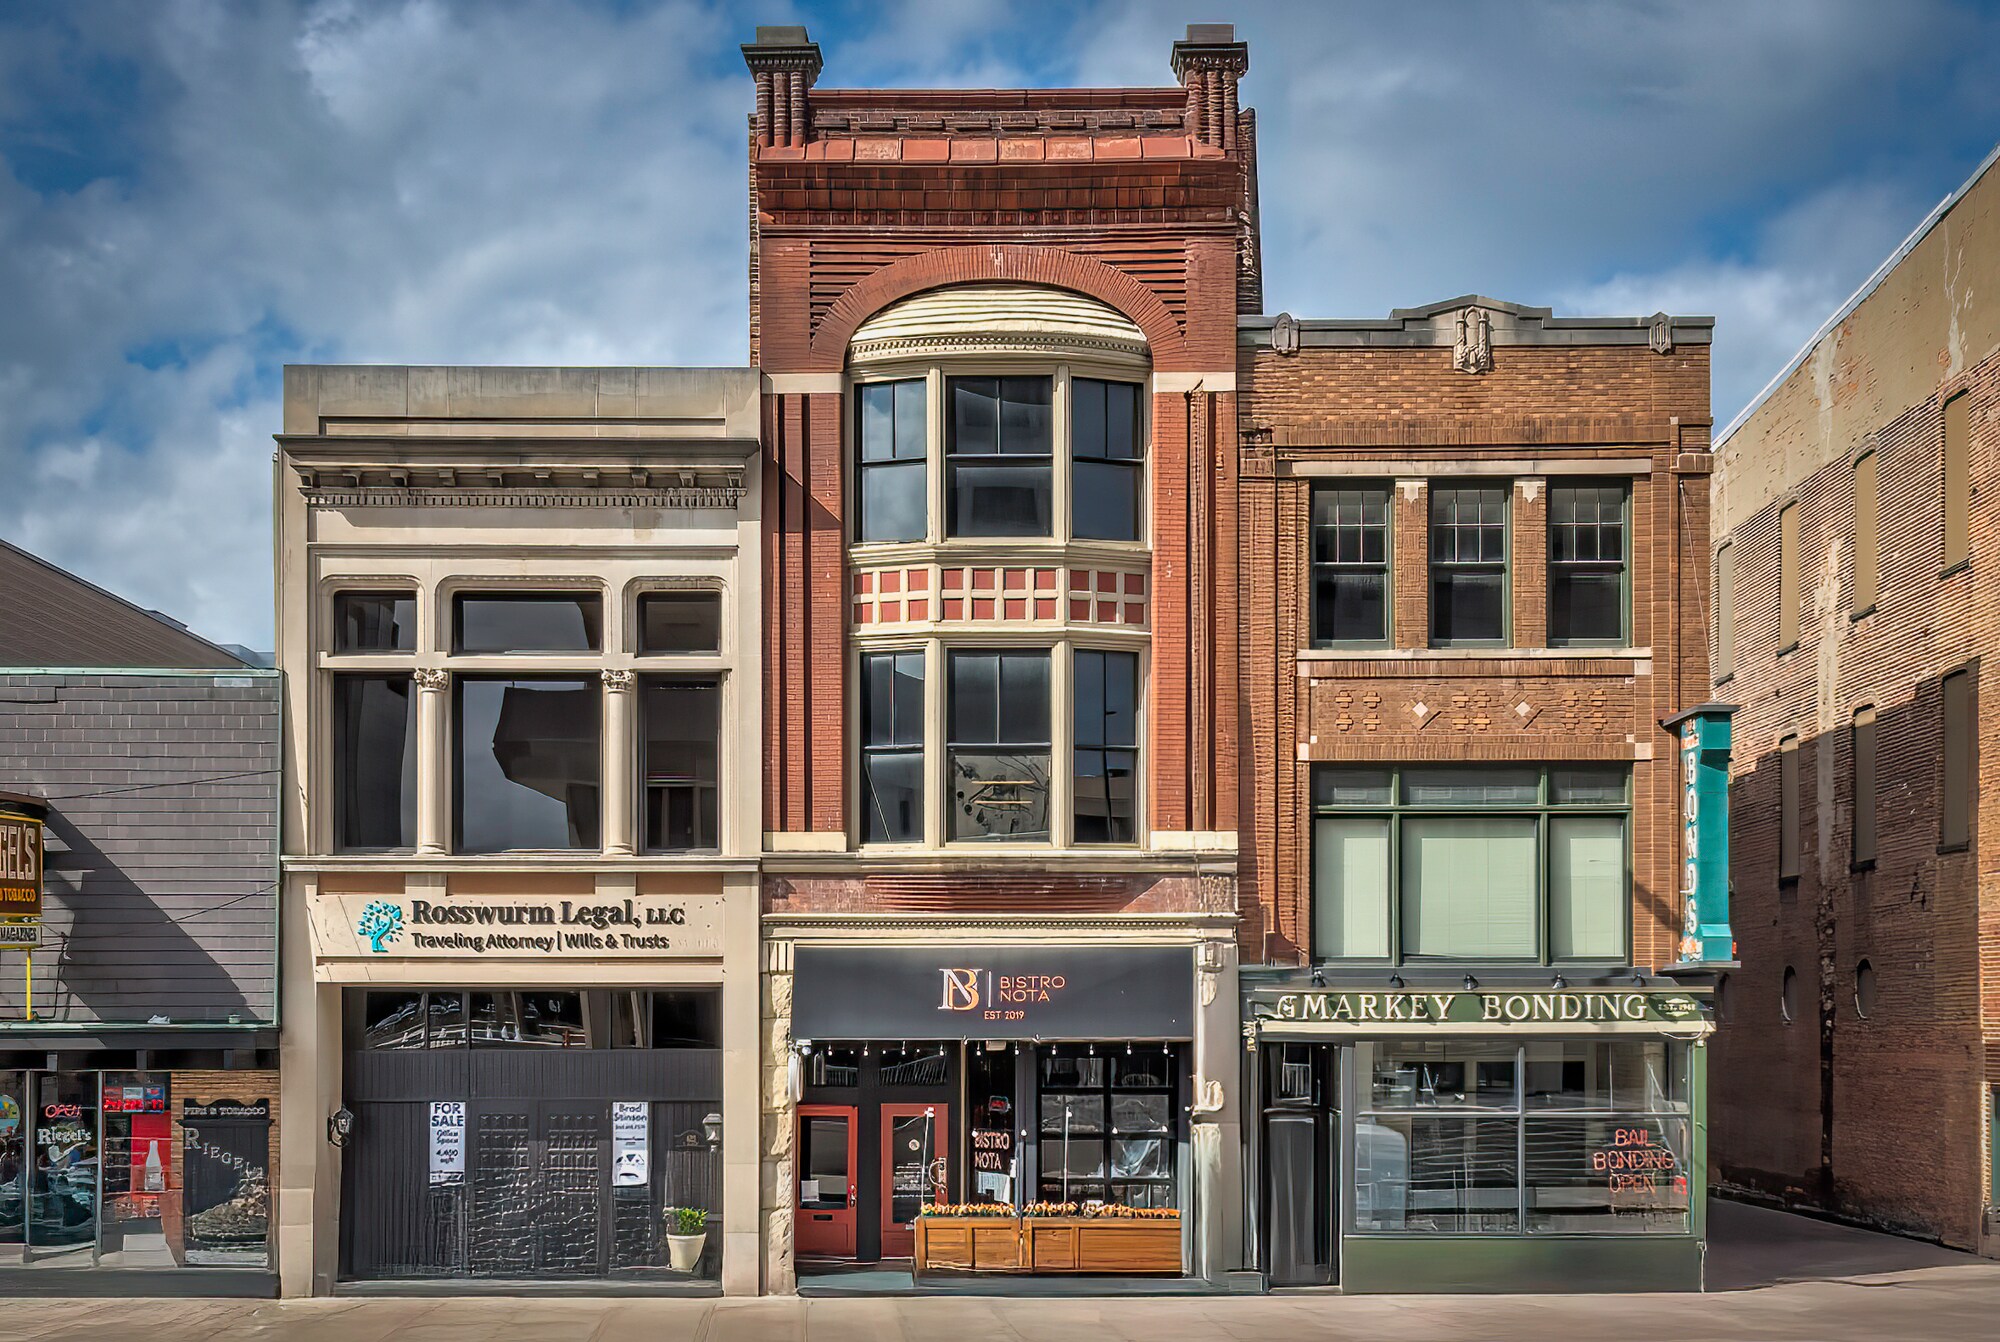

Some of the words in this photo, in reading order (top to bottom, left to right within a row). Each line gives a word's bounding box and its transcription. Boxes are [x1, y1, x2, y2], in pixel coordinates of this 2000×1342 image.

[1684, 751, 1697, 936] BONDS
[411, 900, 556, 926] Rosswurm
[560, 899, 642, 931] Legal,
[646, 907, 685, 925] LLC
[411, 932, 486, 953] Traveling
[486, 933, 555, 953] Attorney
[565, 933, 604, 950] Wills
[605, 934, 619, 949] &
[620, 933, 670, 950] Trusts
[1000, 976, 1066, 989] BISTRO
[1000, 989, 1050, 1002] NOTA
[984, 1010, 1001, 1020] EST
[1005, 1010, 1025, 1020] 2019
[1482, 993, 1648, 1021] BONDING
[434, 1103, 461, 1115] FOR
[432, 1115, 464, 1127] SALE
[974, 1131, 1010, 1150] BISTRO
[1615, 1128, 1657, 1147] BAIL
[974, 1151, 1002, 1170] NOTA
[1593, 1150, 1675, 1170] BONDING
